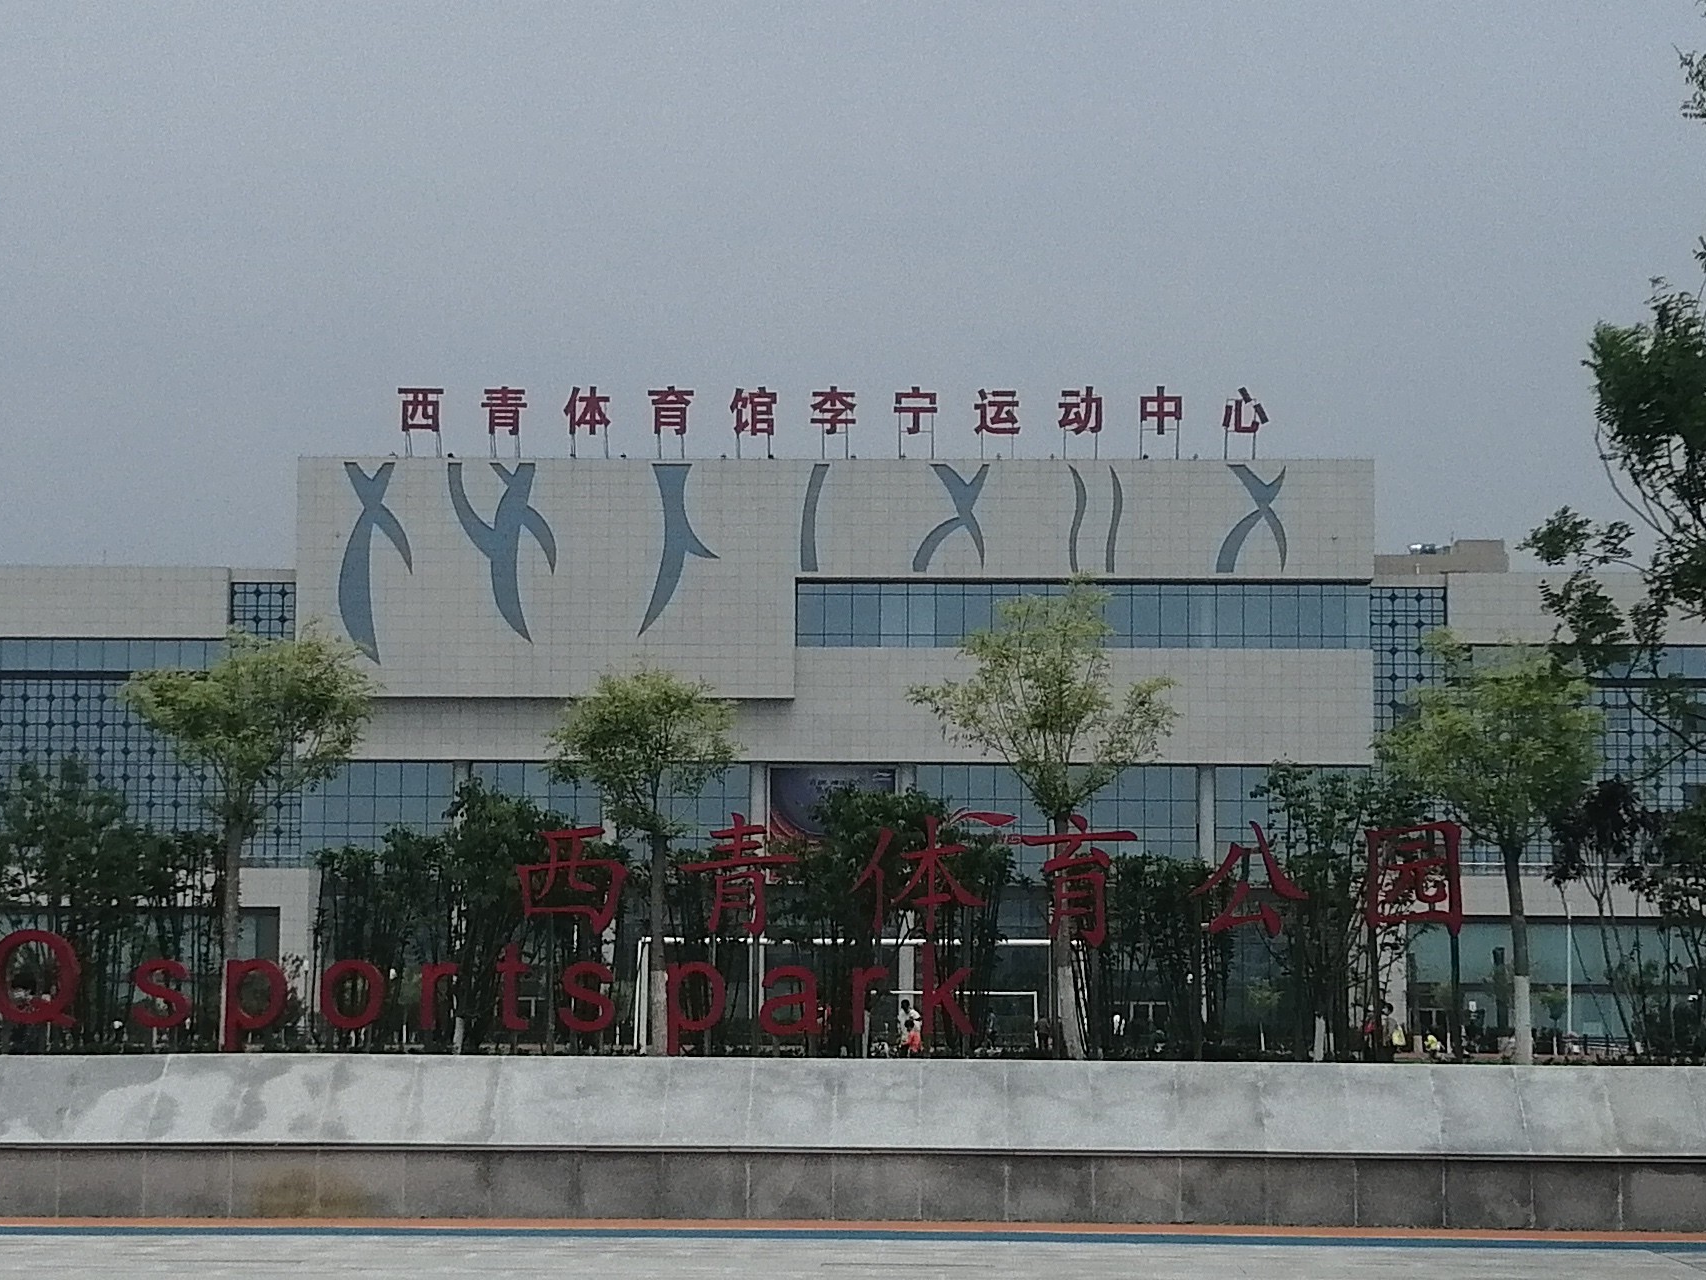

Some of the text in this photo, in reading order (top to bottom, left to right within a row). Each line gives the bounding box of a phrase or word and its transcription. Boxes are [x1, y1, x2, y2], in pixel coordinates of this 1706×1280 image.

[397, 385, 1269, 437] 西青体育馆李宁运动中心
[516, 812, 1464, 948] 西青体育公园
